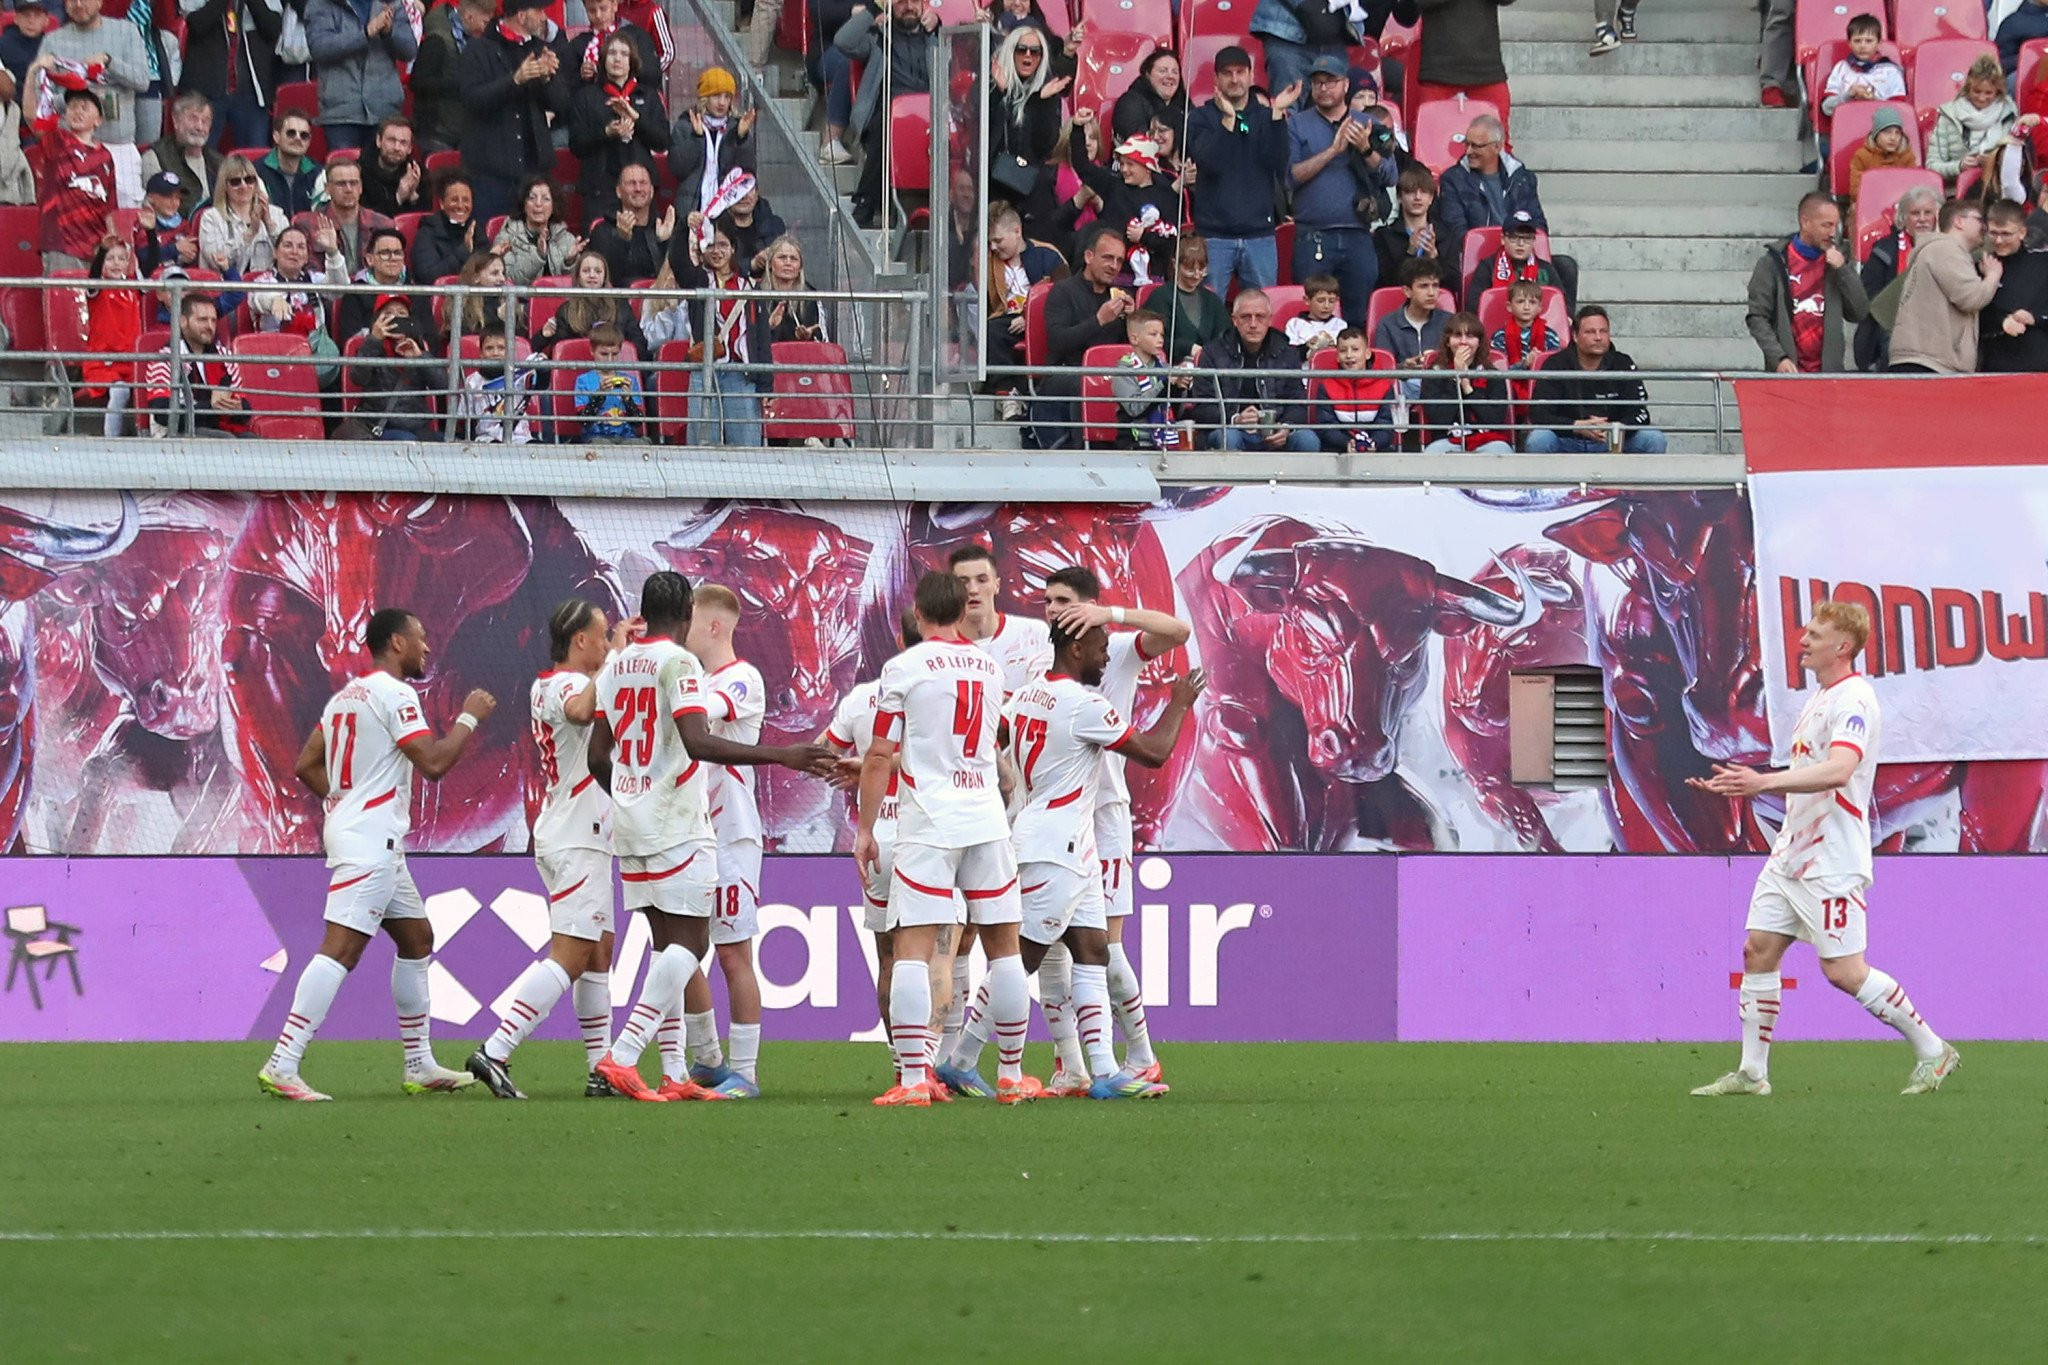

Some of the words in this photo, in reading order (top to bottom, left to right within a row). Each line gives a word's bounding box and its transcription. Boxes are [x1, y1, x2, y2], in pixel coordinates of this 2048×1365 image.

[926, 656, 945, 672] RB
[948, 656, 995, 676] LEIPZIG
[330, 712, 357, 790] 11
[614, 687, 657, 767] 23
[953, 680, 983, 758] 4
[1014, 713, 1047, 792] 17
[715, 885, 739, 917] 18
[1822, 897, 1848, 930] 13
